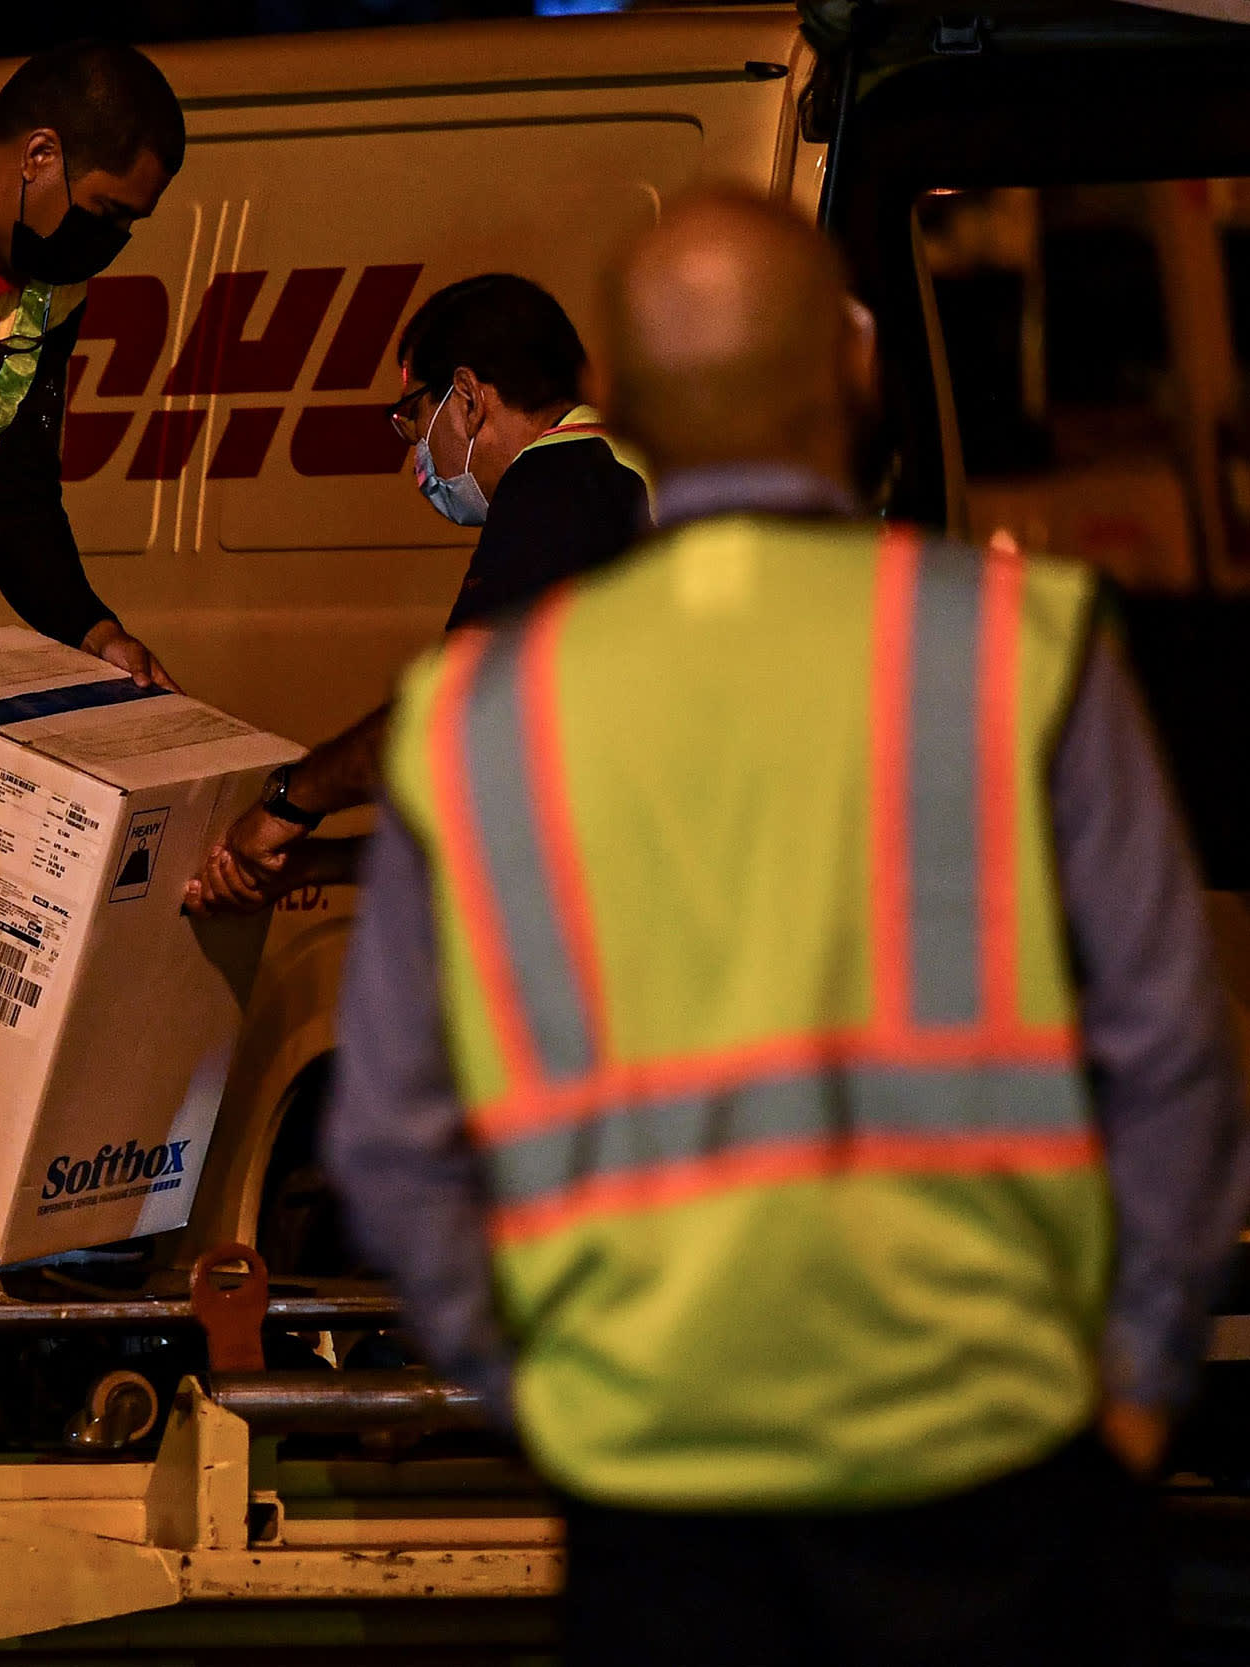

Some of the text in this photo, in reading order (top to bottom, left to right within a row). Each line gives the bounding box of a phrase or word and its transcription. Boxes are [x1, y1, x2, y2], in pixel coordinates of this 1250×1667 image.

[61, 263, 425, 483] DHL
[131, 822, 161, 838] HEAVY
[41, 1138, 191, 1200] Softbox
